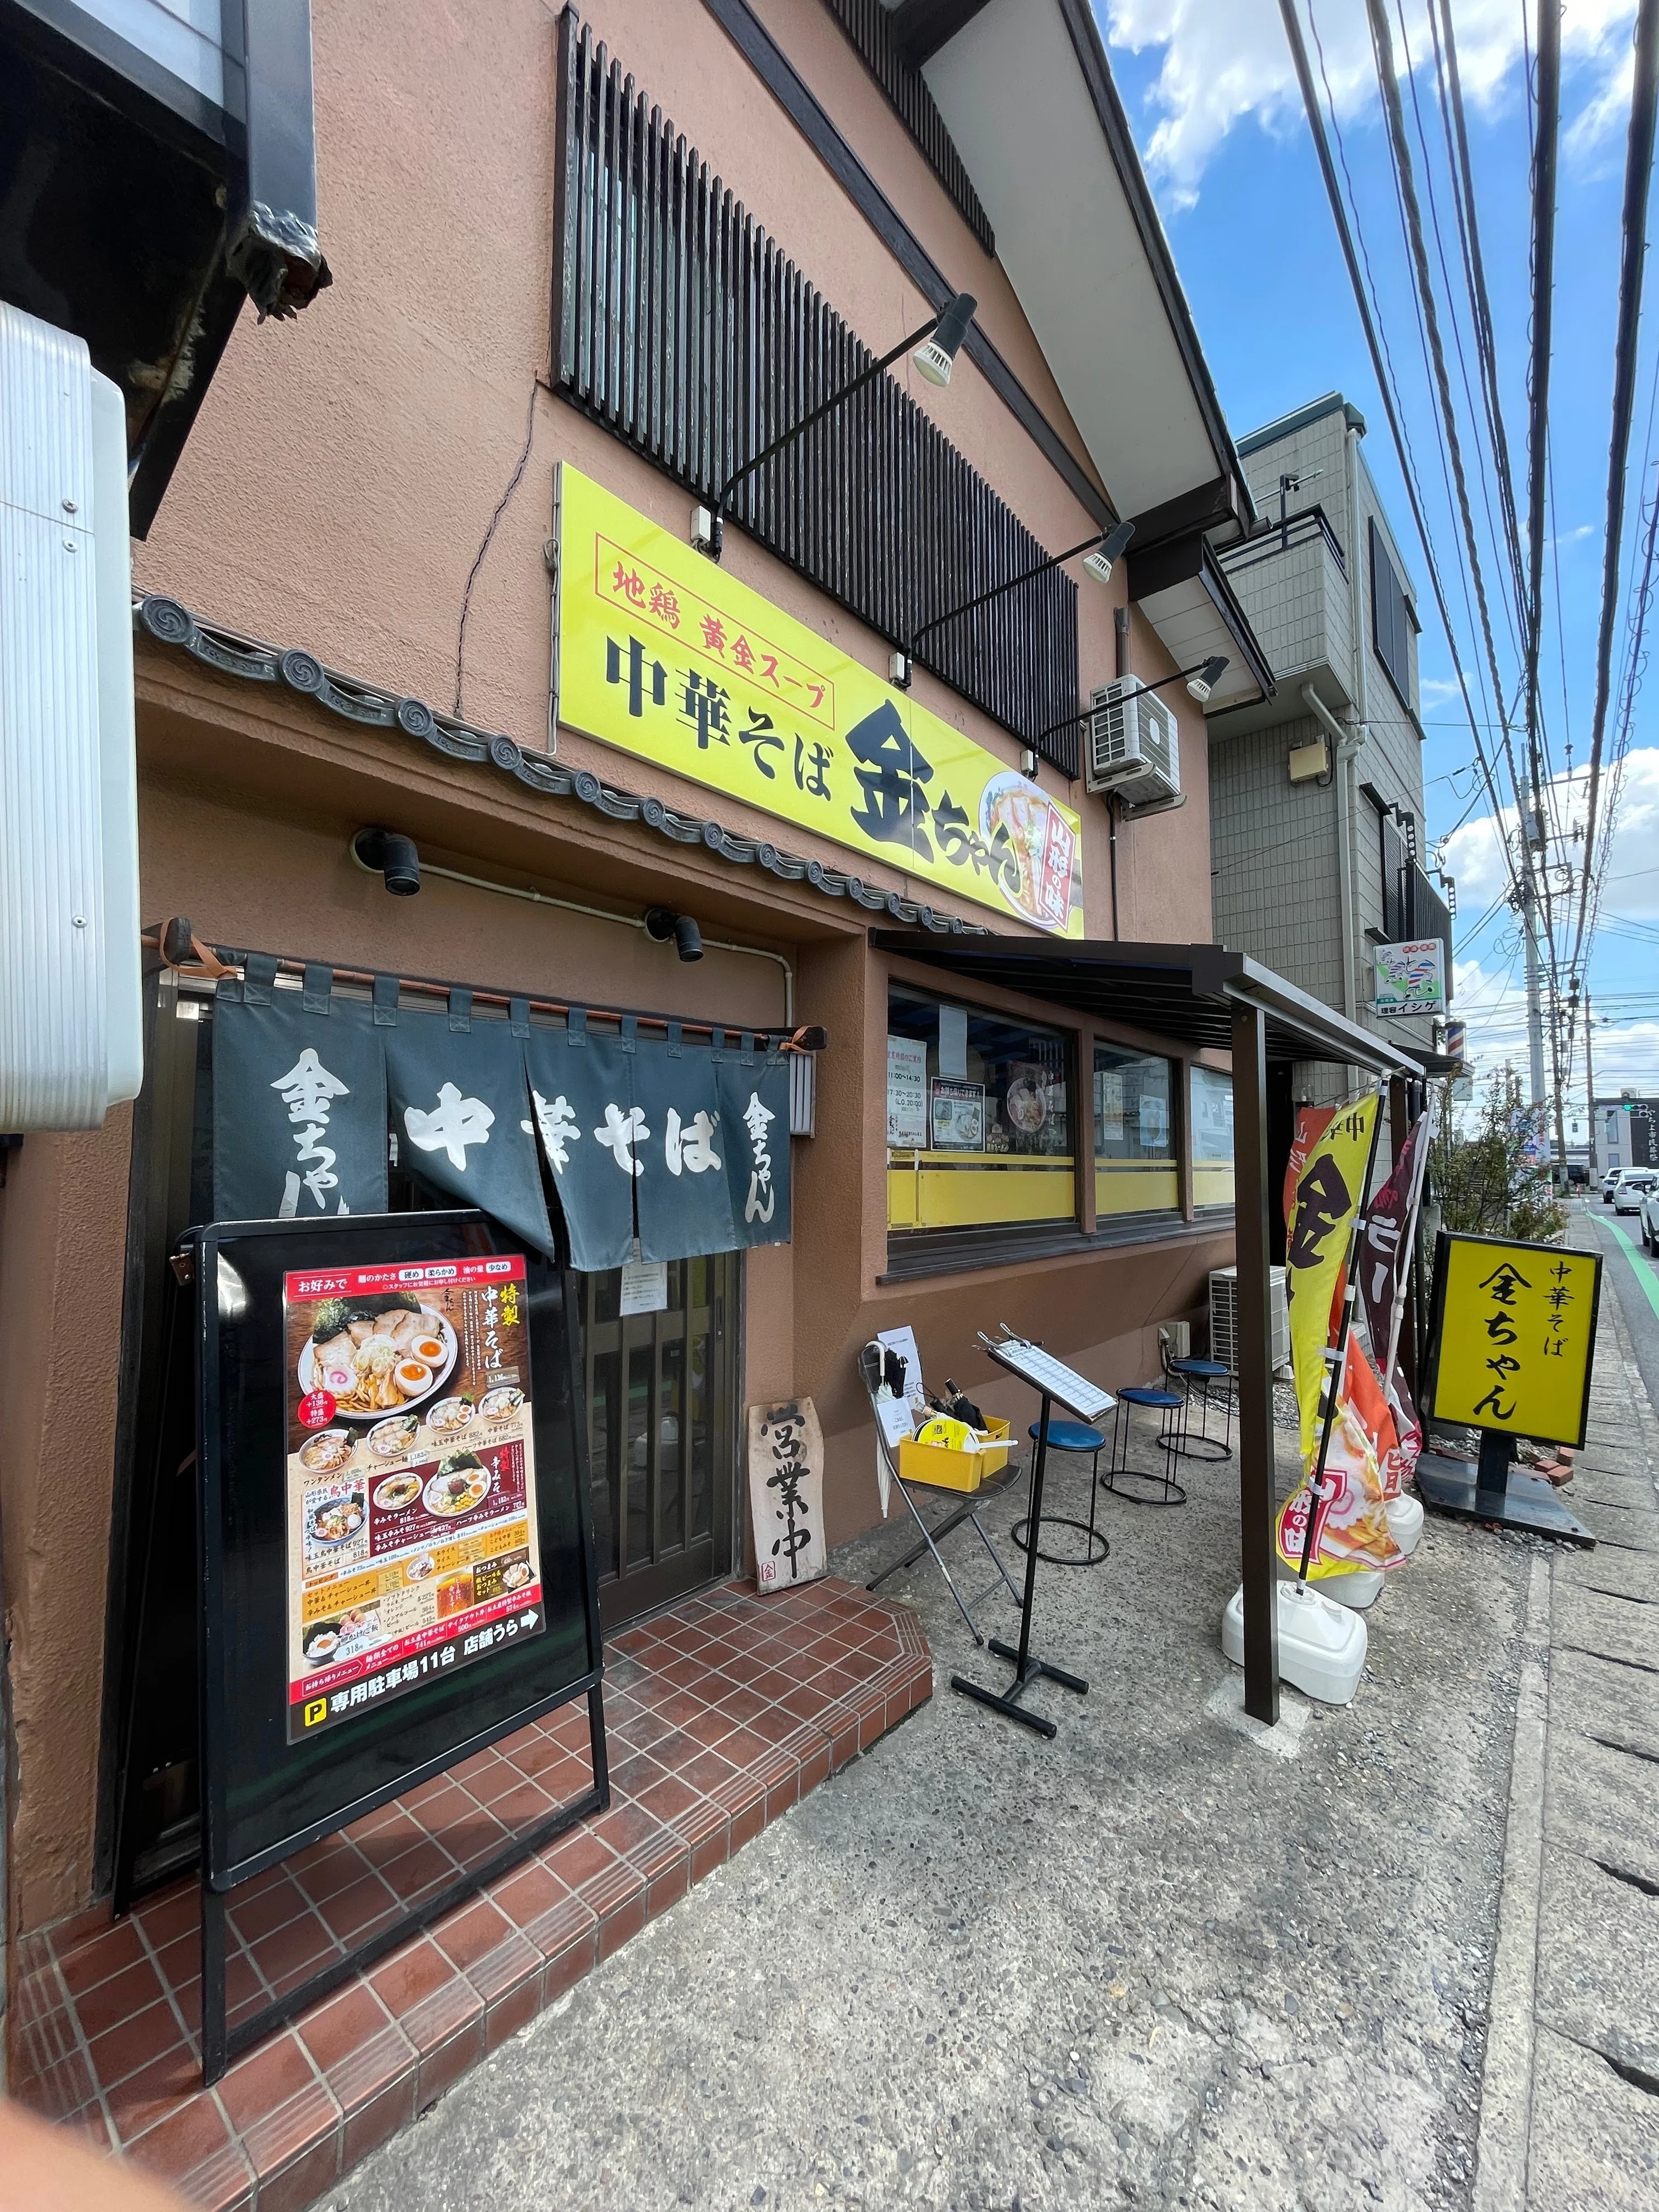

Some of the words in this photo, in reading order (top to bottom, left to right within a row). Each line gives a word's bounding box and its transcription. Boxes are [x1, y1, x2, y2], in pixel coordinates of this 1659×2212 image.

[612, 561, 681, 629] 地鶏
[699, 613, 827, 709] 黄金スープ
[605, 634, 833, 802] 中華そば
[845, 698, 1023, 894] 金ちゃん
[1381, 1001, 1437, 1014] 理容イシゲ
[404, 1081, 723, 1177] 中華そば
[742, 1092, 776, 1223] 金ちゃん
[298, 1278, 348, 1293] お好みで
[358, 1272, 396, 1284] 麺のかたさ
[404, 1271, 419, 1279] 硬め
[428, 1268, 455, 1277] 柔らかめ
[463, 1265, 484, 1274] 油の量
[500, 1283, 520, 1326] 特製
[1543, 1261, 1575, 1357] 中華そば
[481, 1286, 504, 1369] 中華そば
[1472, 1262, 1532, 1420] 金ちゃん
[311, 1392, 324, 1400] 大盛
[488, 1423, 509, 1433] 中華そば
[303, 1473, 342, 1486] ワンタンメン
[330, 1479, 365, 1497] 鳥中華
[761, 1404, 811, 1579] 営業中
[374, 1508, 417, 1525] 辛みそラーメン
[476, 1562, 498, 1574] おつまみ
[330, 1646, 456, 1713] 専用駐車場11台
[463, 1619, 518, 1657] 店舗うら
[309, 1703, 322, 1722] P
